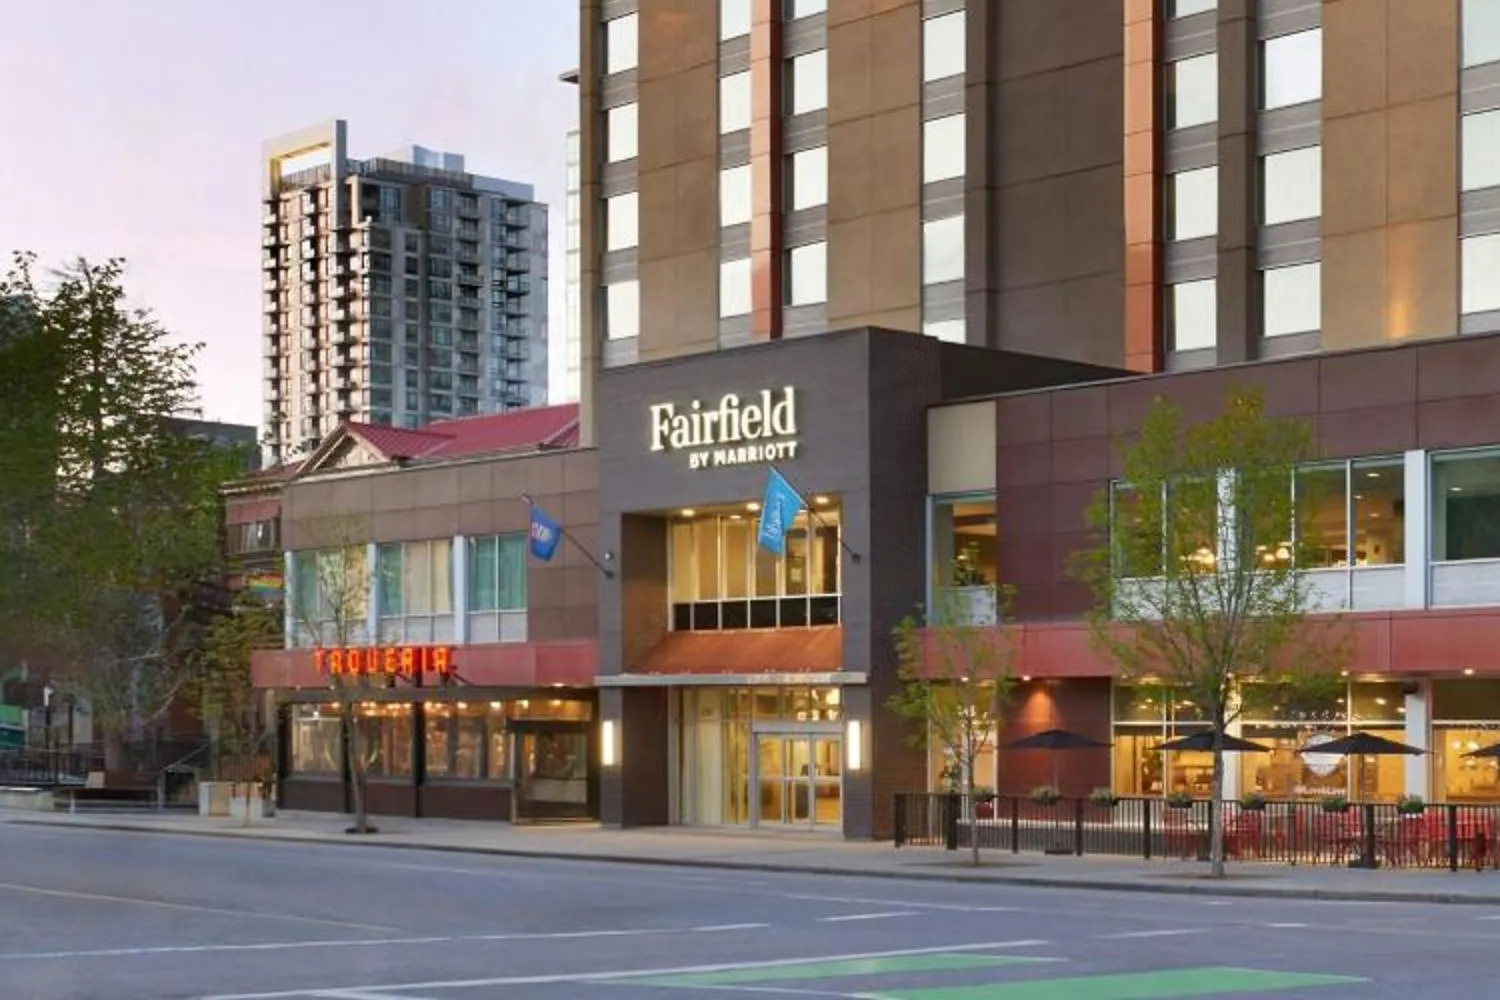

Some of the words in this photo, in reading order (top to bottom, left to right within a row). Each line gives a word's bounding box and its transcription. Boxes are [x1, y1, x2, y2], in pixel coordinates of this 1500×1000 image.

[650, 386, 796, 450] Fairfield
[689, 451, 709, 469] BY
[713, 441, 797, 467] MARRIOTT
[314, 647, 450, 674] TAQUERIA
